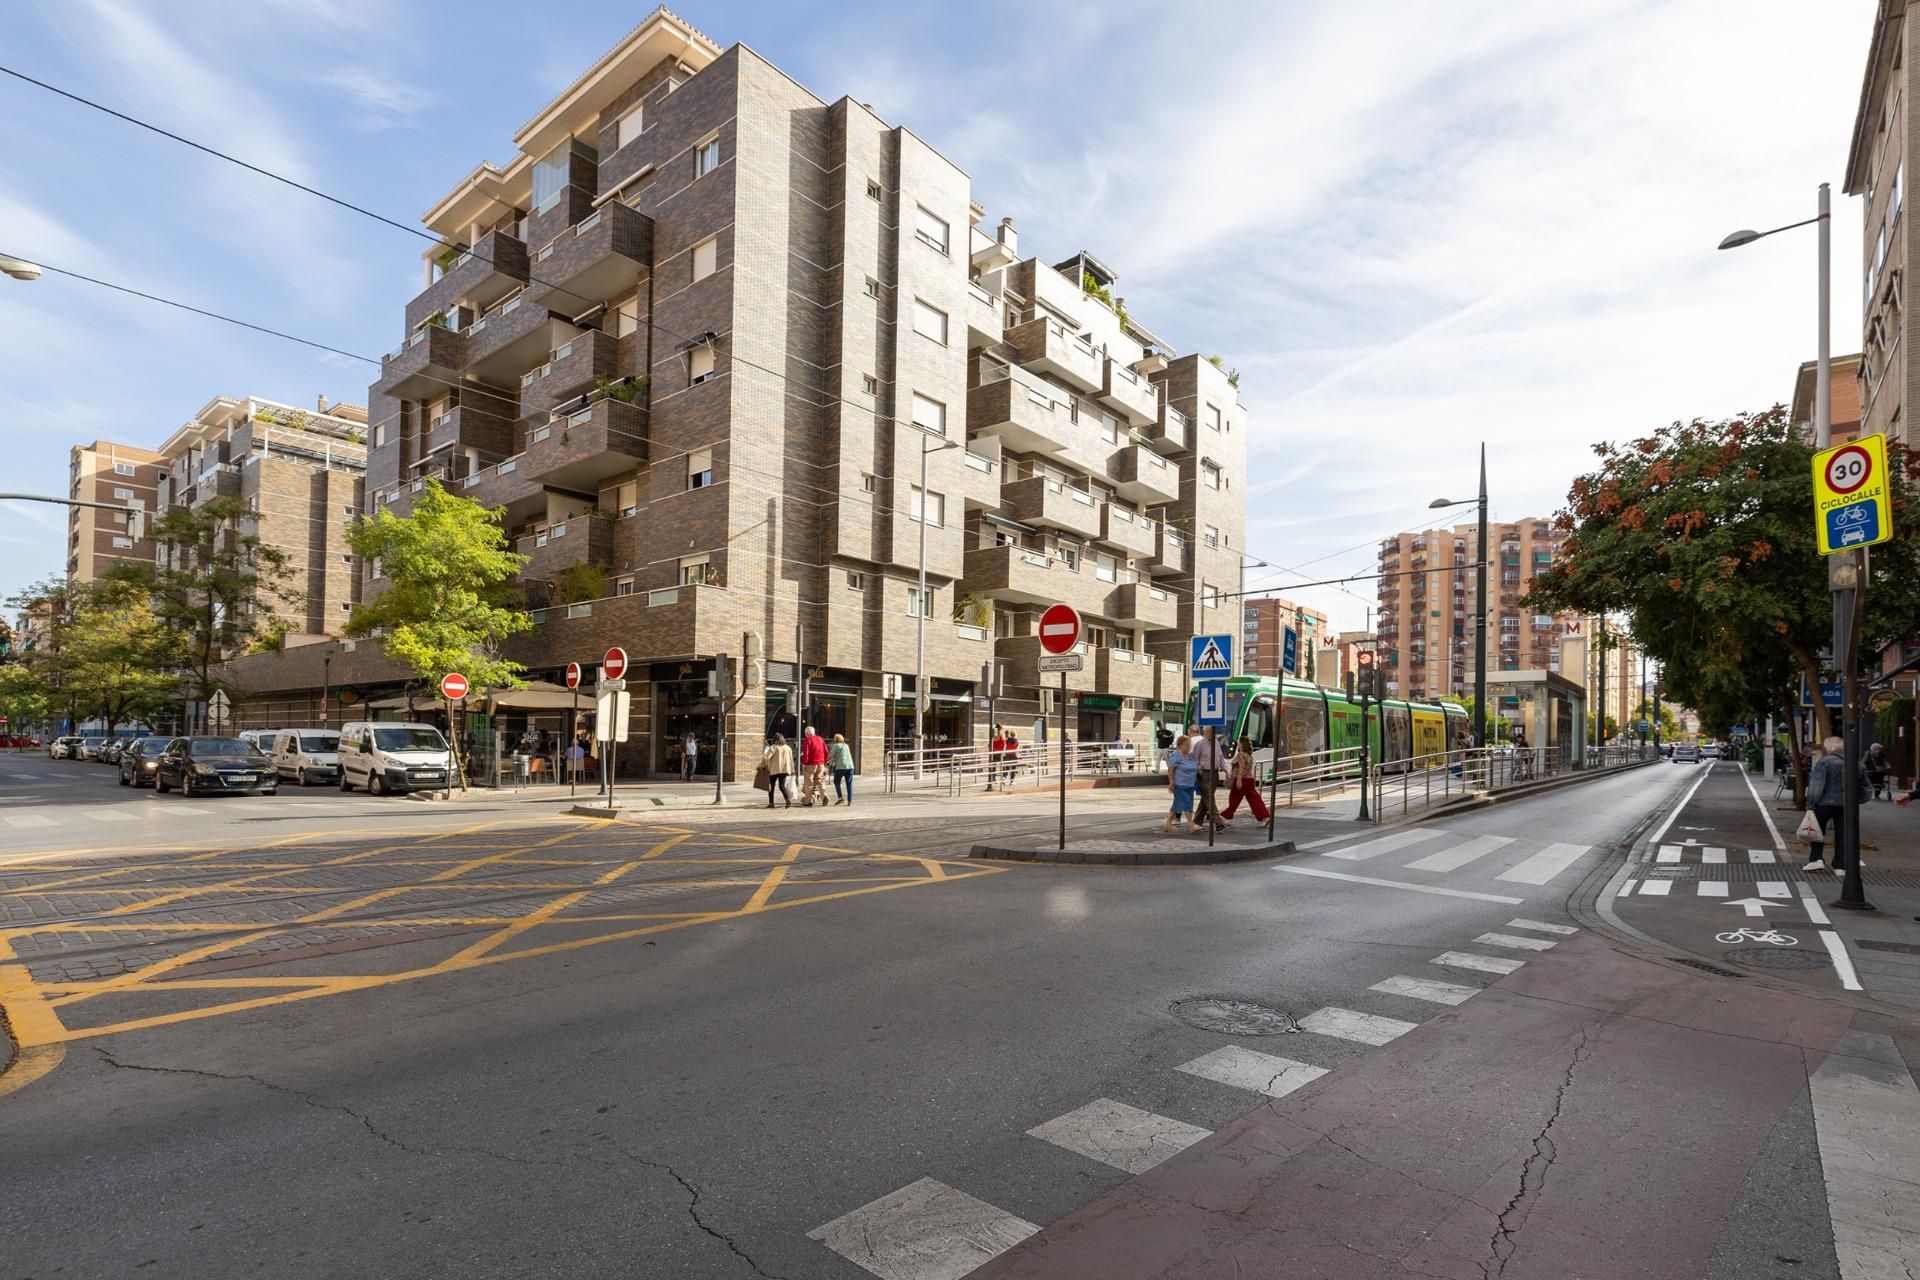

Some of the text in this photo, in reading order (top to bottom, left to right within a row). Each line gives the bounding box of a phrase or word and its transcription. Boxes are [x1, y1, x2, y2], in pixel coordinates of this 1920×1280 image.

[1835, 460, 1862, 481] 30
[1820, 487, 1882, 510] CICLOCALLE
[1567, 622, 1580, 634] M
[1323, 636, 1334, 647] M
[1208, 693, 1215, 706] 1
